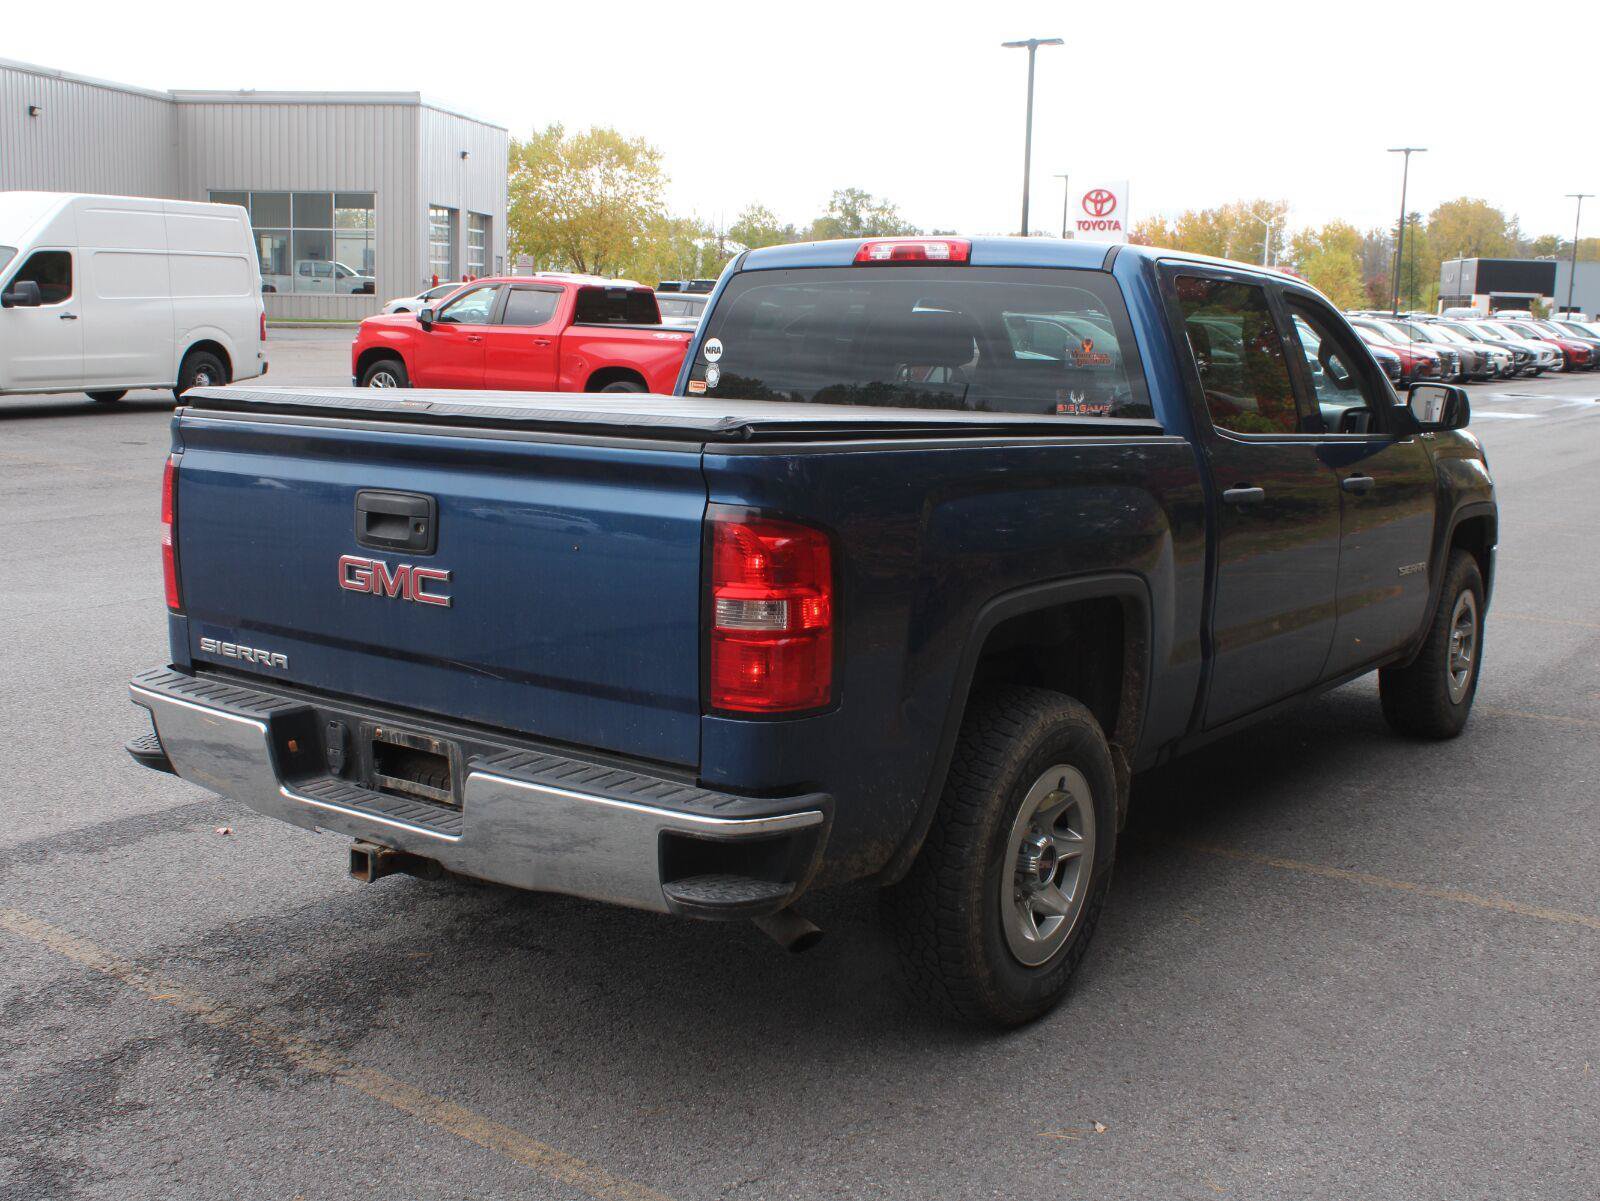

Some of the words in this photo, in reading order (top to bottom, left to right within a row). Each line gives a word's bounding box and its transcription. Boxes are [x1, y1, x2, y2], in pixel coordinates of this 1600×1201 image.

[1076, 220, 1121, 231] TOYOTA
[705, 346, 721, 355] NRA
[339, 554, 451, 607] GMC
[200, 637, 289, 670] SIERRA
